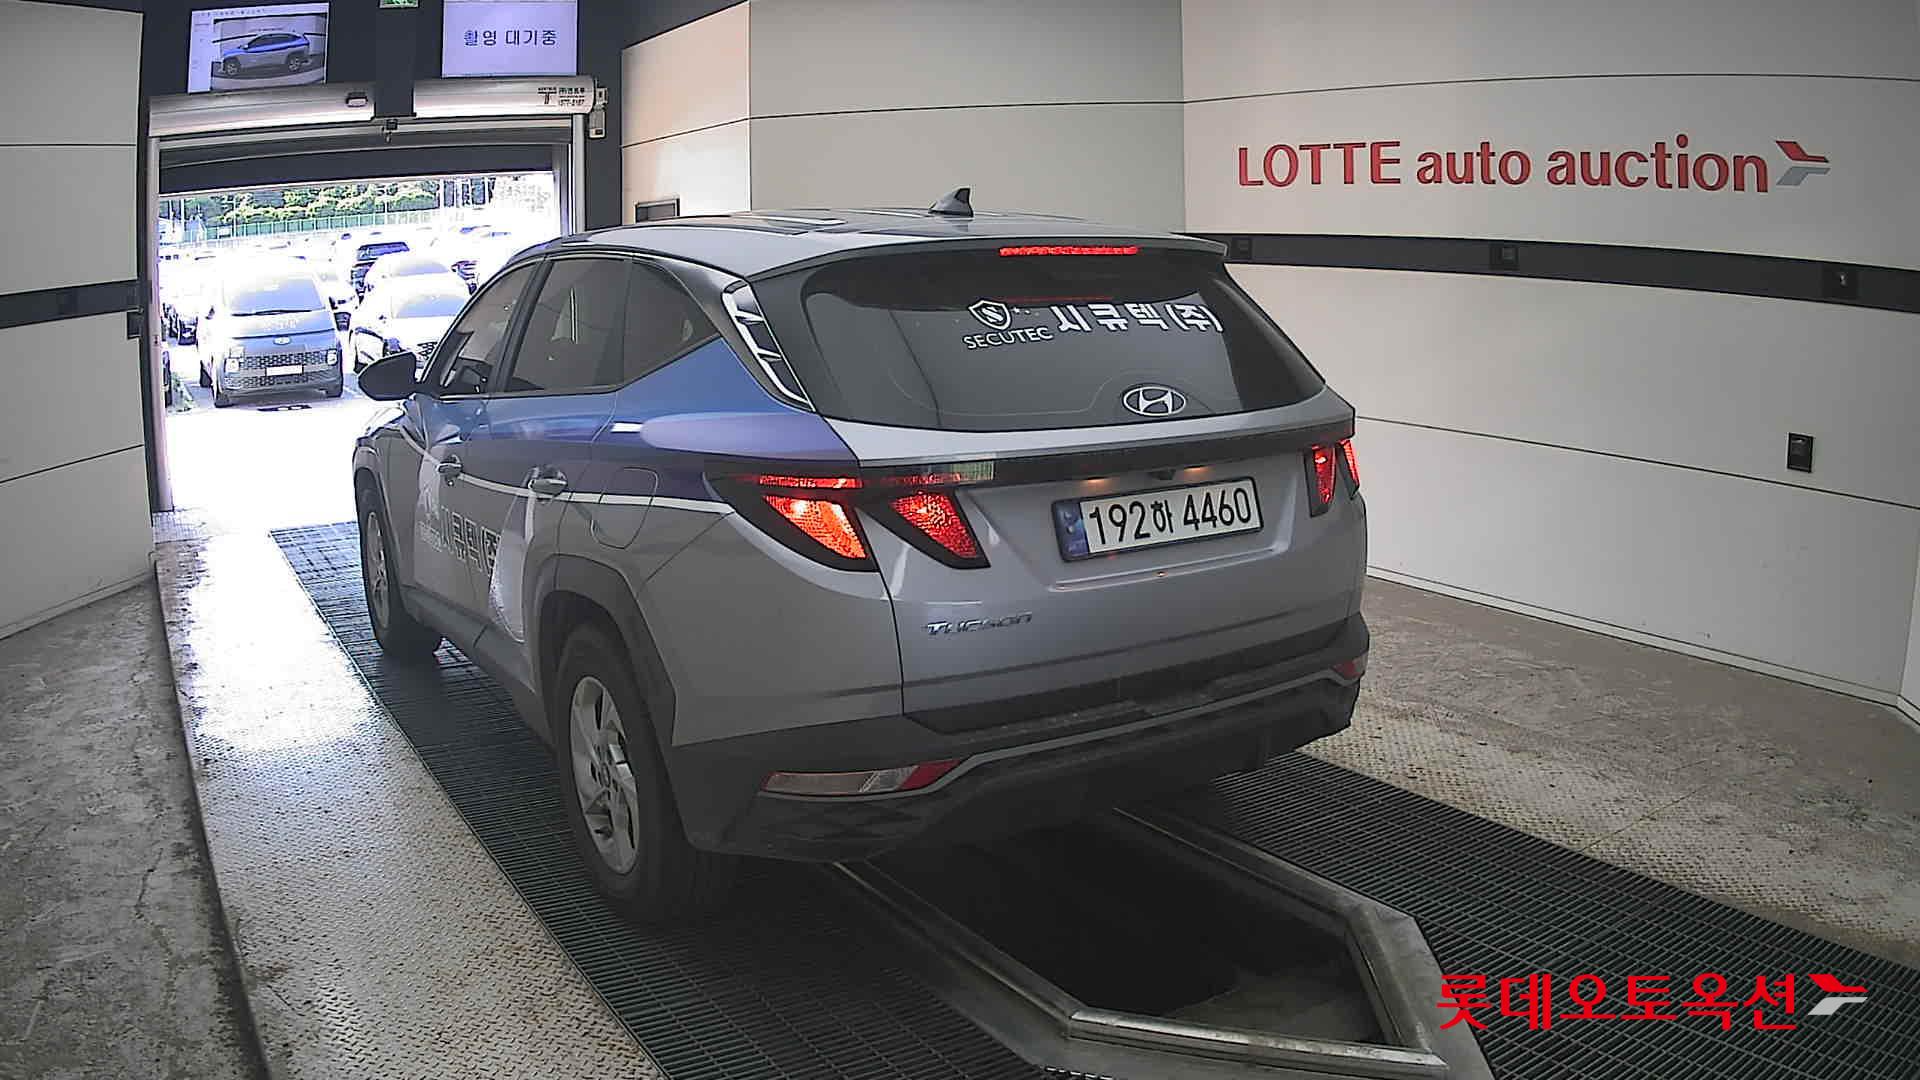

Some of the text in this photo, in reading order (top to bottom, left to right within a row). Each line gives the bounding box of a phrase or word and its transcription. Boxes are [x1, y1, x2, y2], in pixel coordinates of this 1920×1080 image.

[505, 29, 558, 46] 대기중
[1238, 134, 1769, 193] LOTTE auto auction
[962, 327, 1054, 350] SECUTEC
[1089, 487, 1252, 545] 192하 4460
